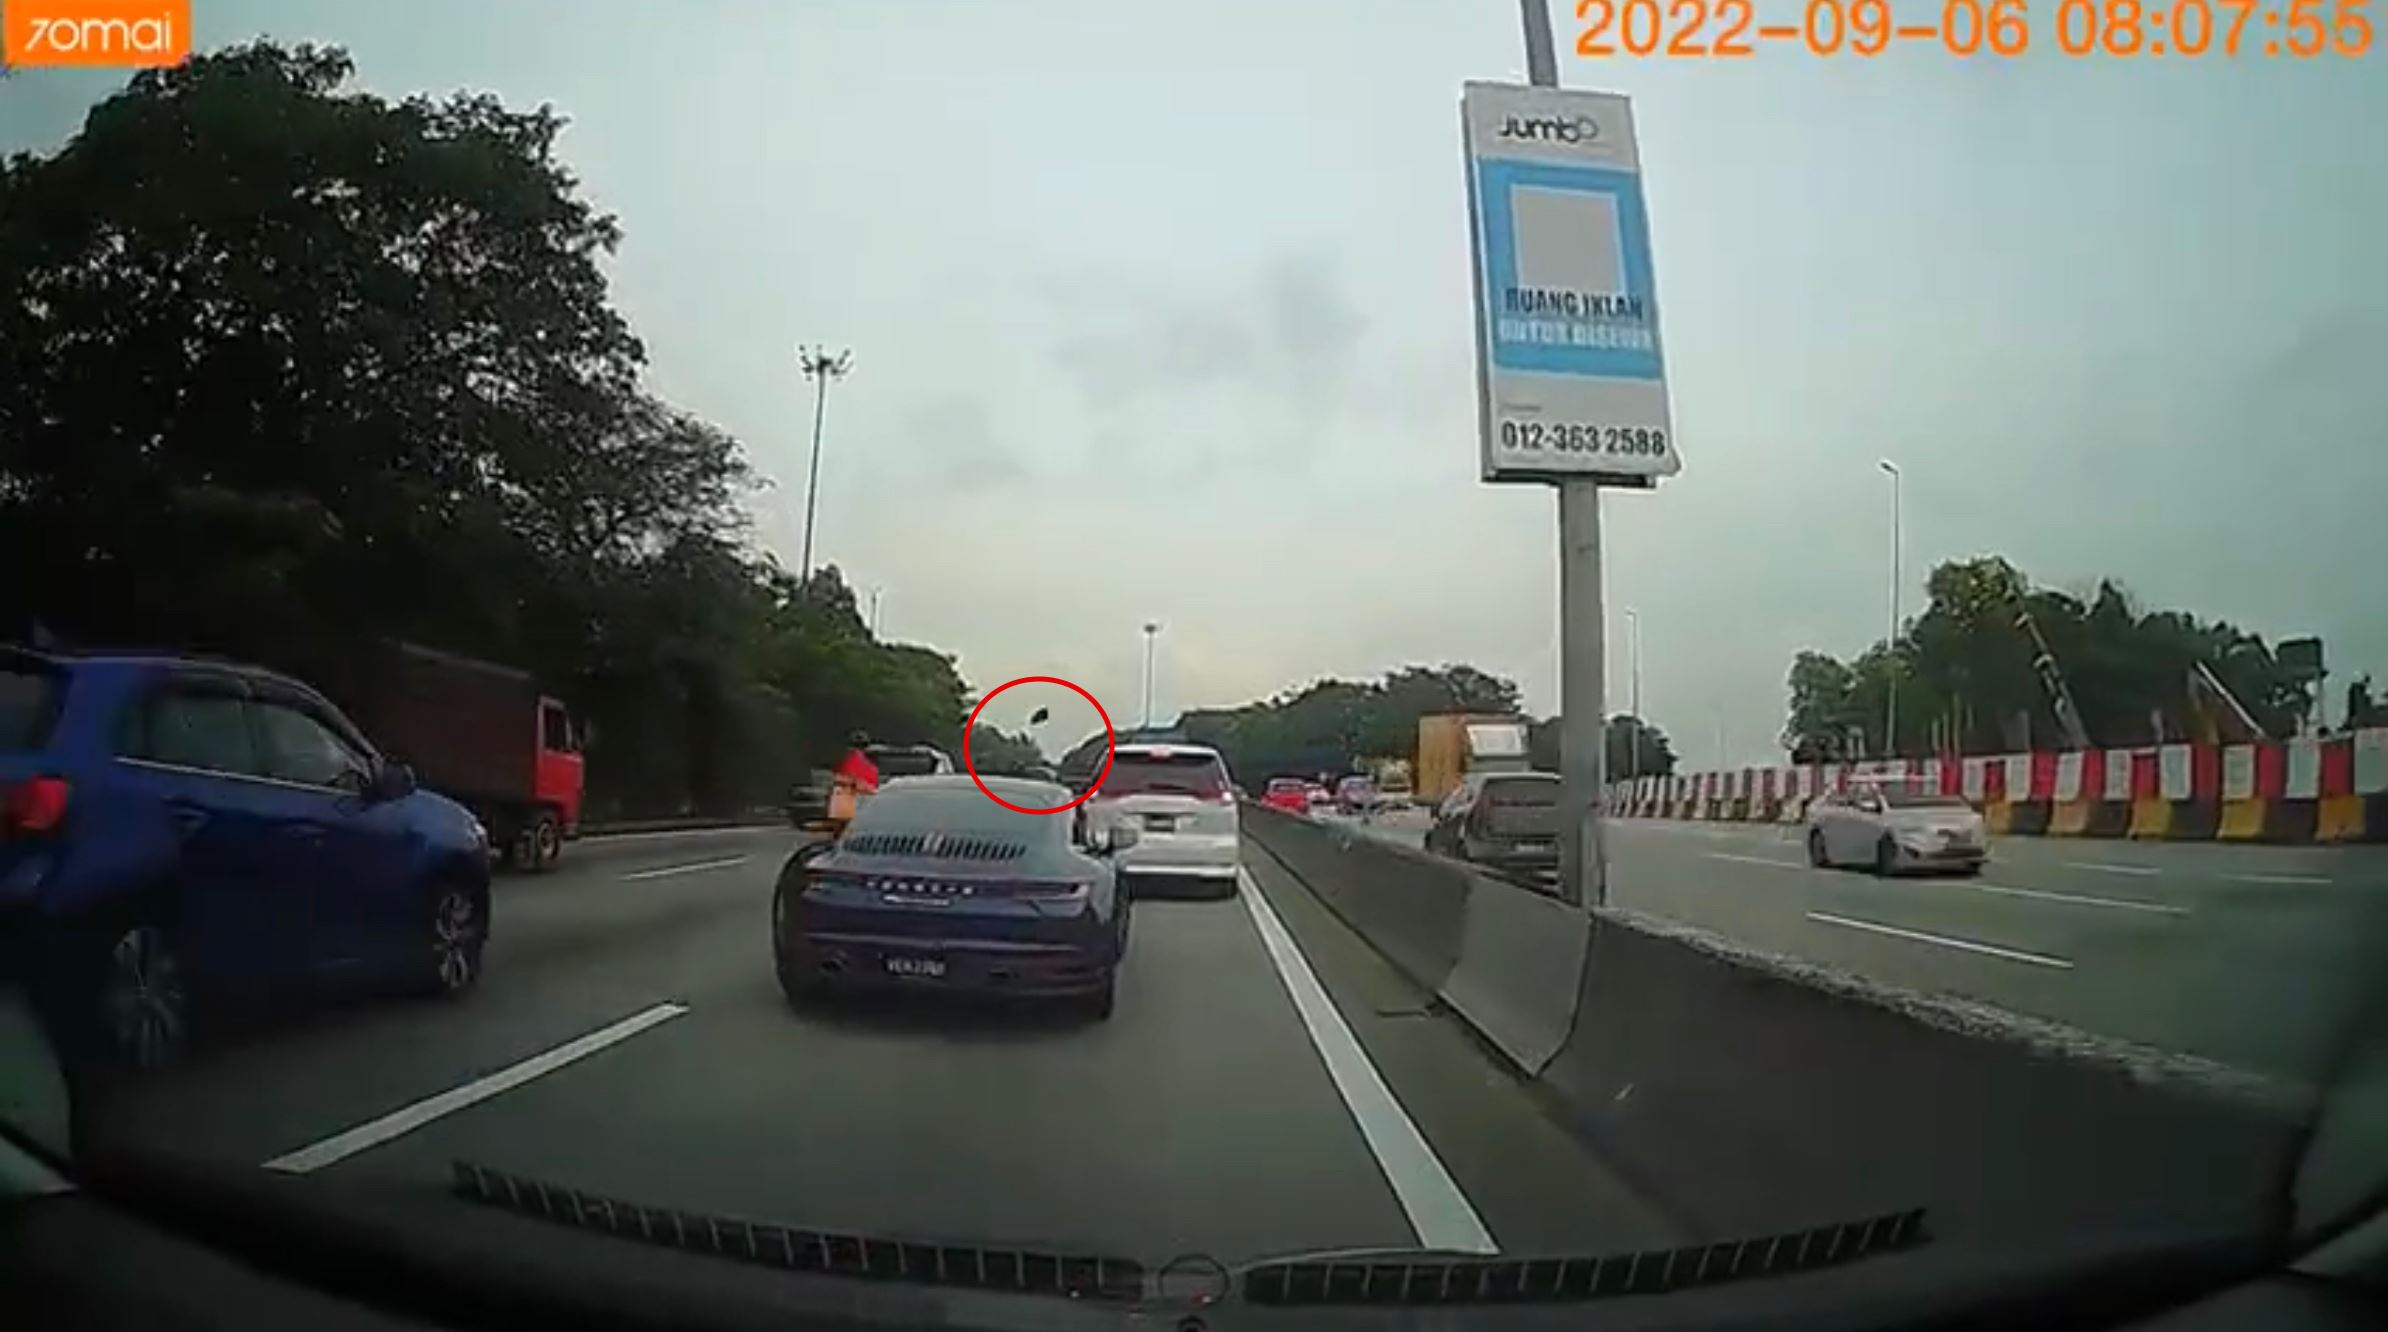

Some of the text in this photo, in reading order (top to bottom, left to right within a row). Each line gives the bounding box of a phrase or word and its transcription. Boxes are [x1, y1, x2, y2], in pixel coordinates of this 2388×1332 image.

[1506, 287, 1643, 321] RUANG IKLAN
[1502, 421, 1665, 456] 012-363 2588
